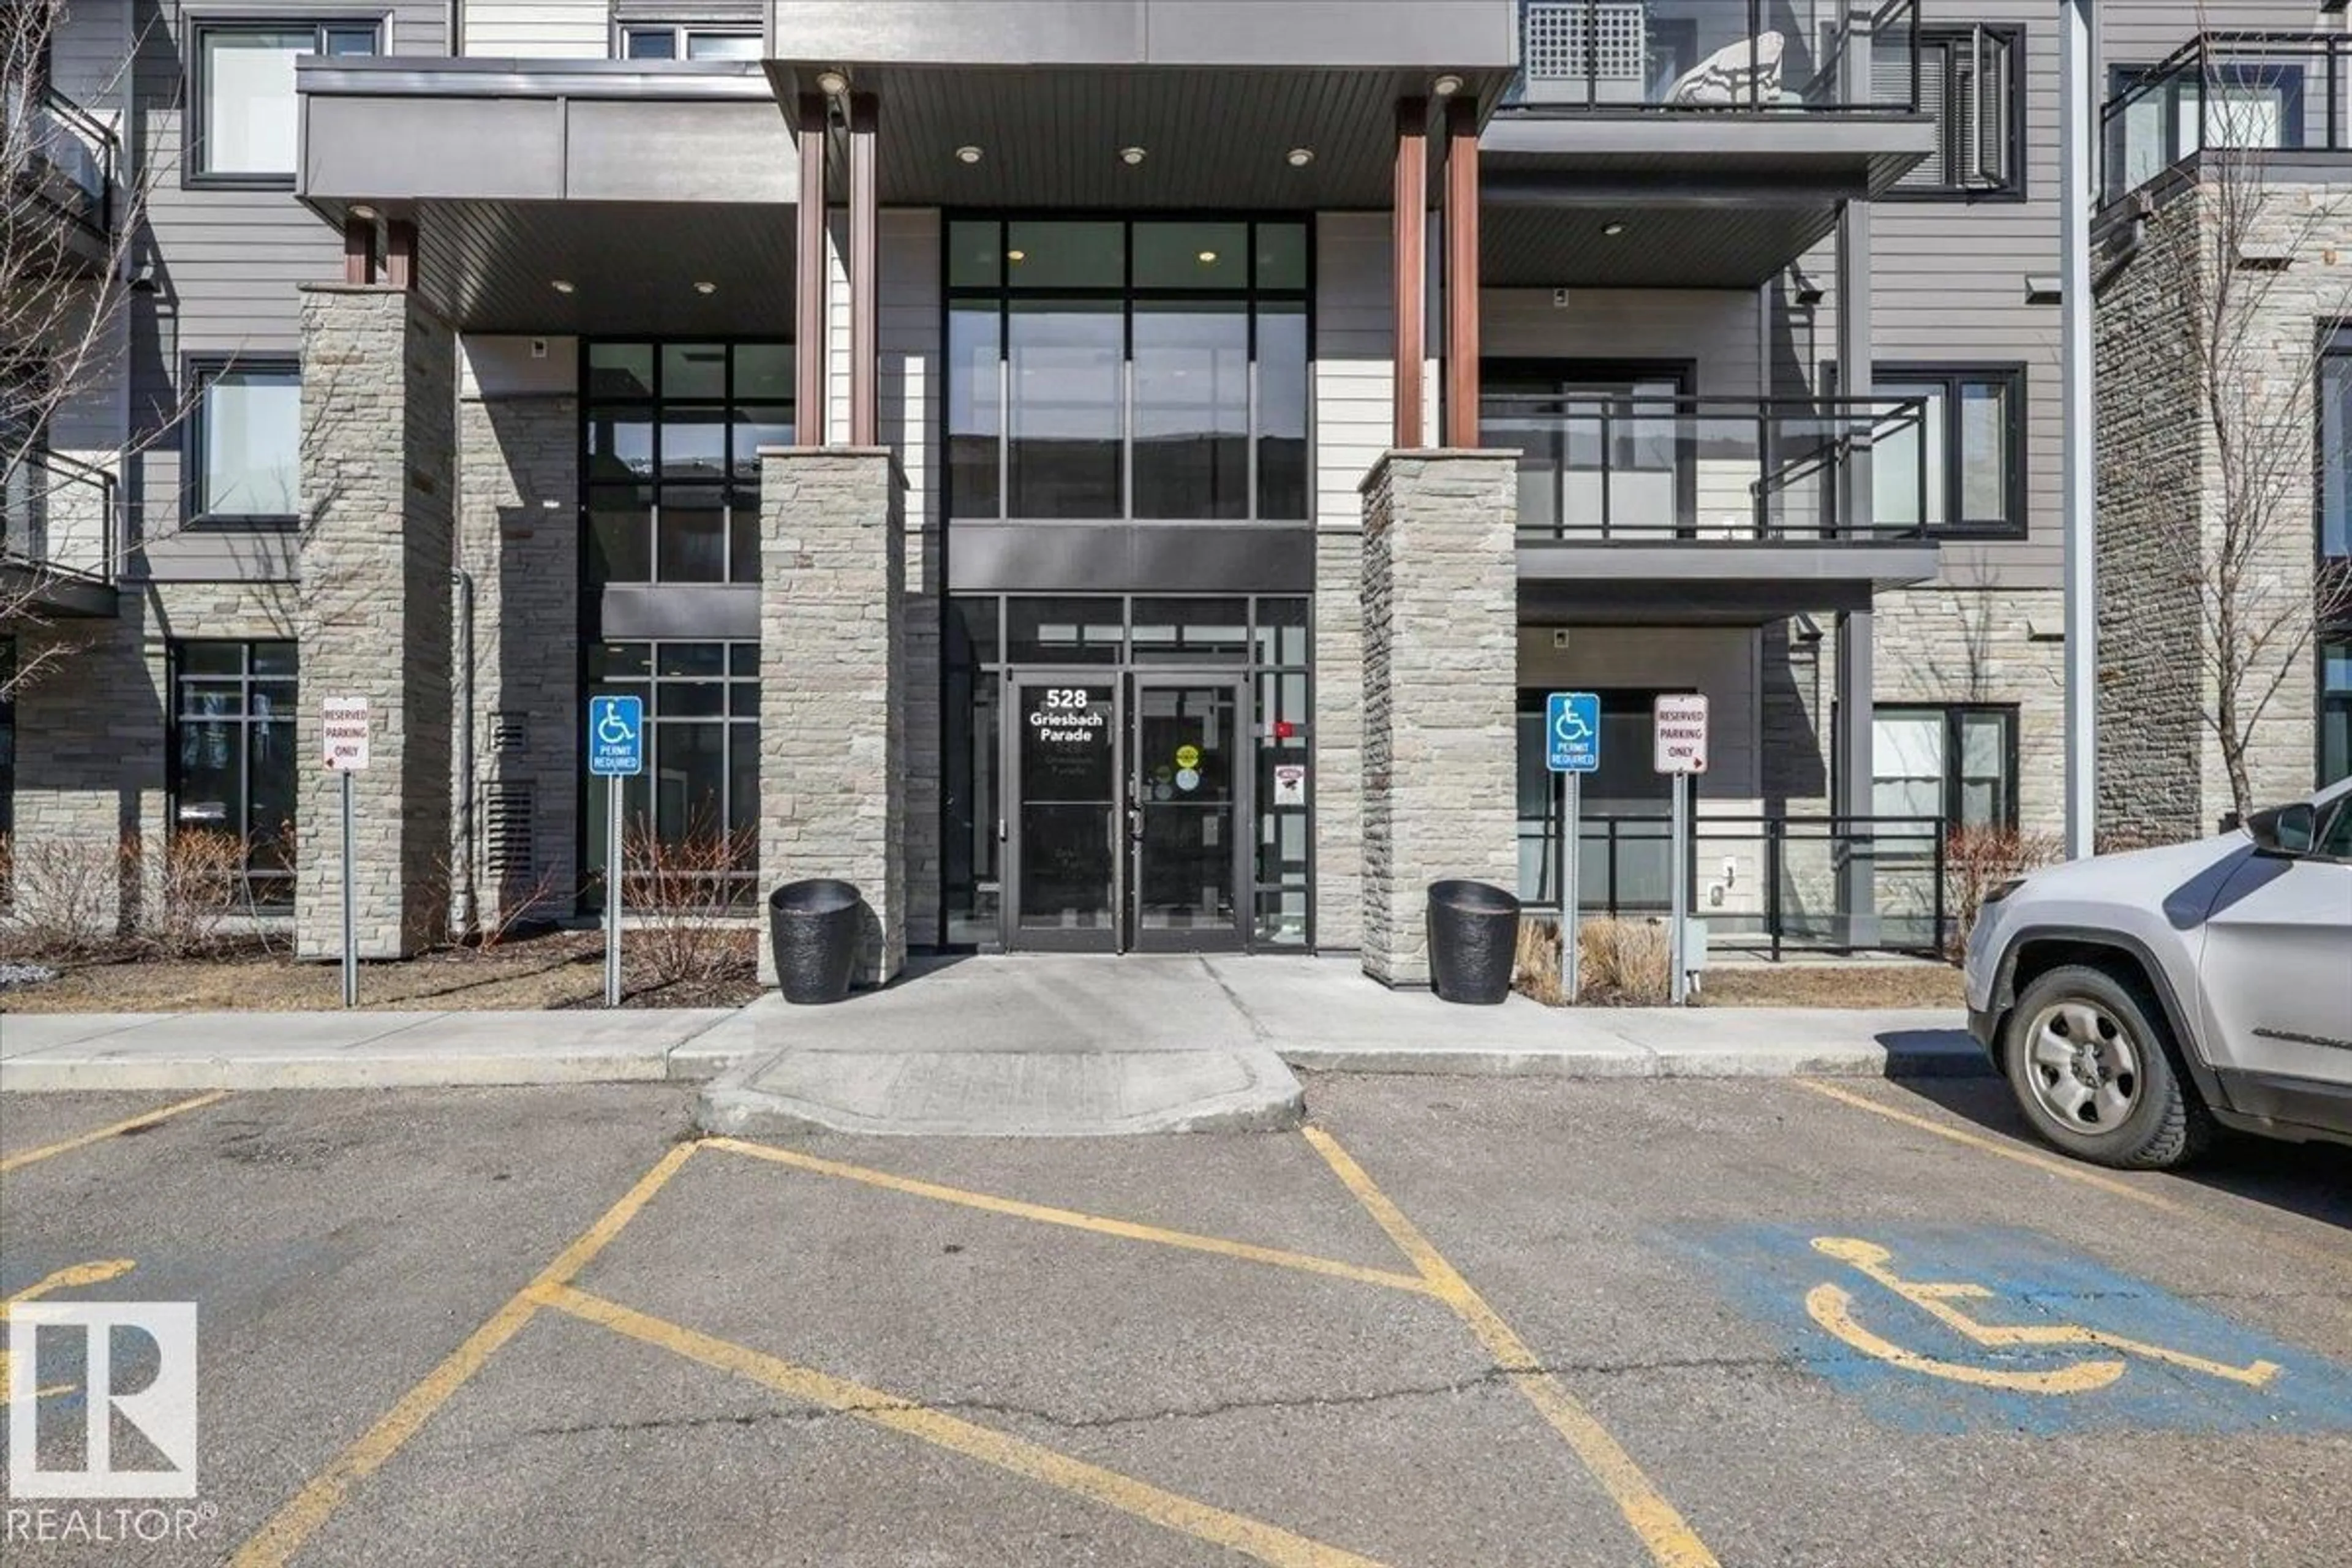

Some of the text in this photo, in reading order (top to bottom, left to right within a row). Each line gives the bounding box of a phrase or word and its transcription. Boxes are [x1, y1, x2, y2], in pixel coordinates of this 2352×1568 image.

[1047, 689, 1088, 708] 528
[325, 710, 367, 720] RESERVED
[1030, 712, 1102, 726] Griesbach
[1660, 711, 1703, 722] RESERVED
[325, 727, 367, 738] PARKING
[1041, 727, 1093, 742] Parade
[1660, 728, 1702, 739] PARKING
[334, 745, 358, 757] ONLY
[600, 745, 632, 755] PERMIT
[1558, 742, 1589, 753] PERMIT
[1668, 746, 1694, 757] ONLY
[594, 756, 638, 767] REQUIRED
[1552, 754, 1594, 765] REQUIRED
